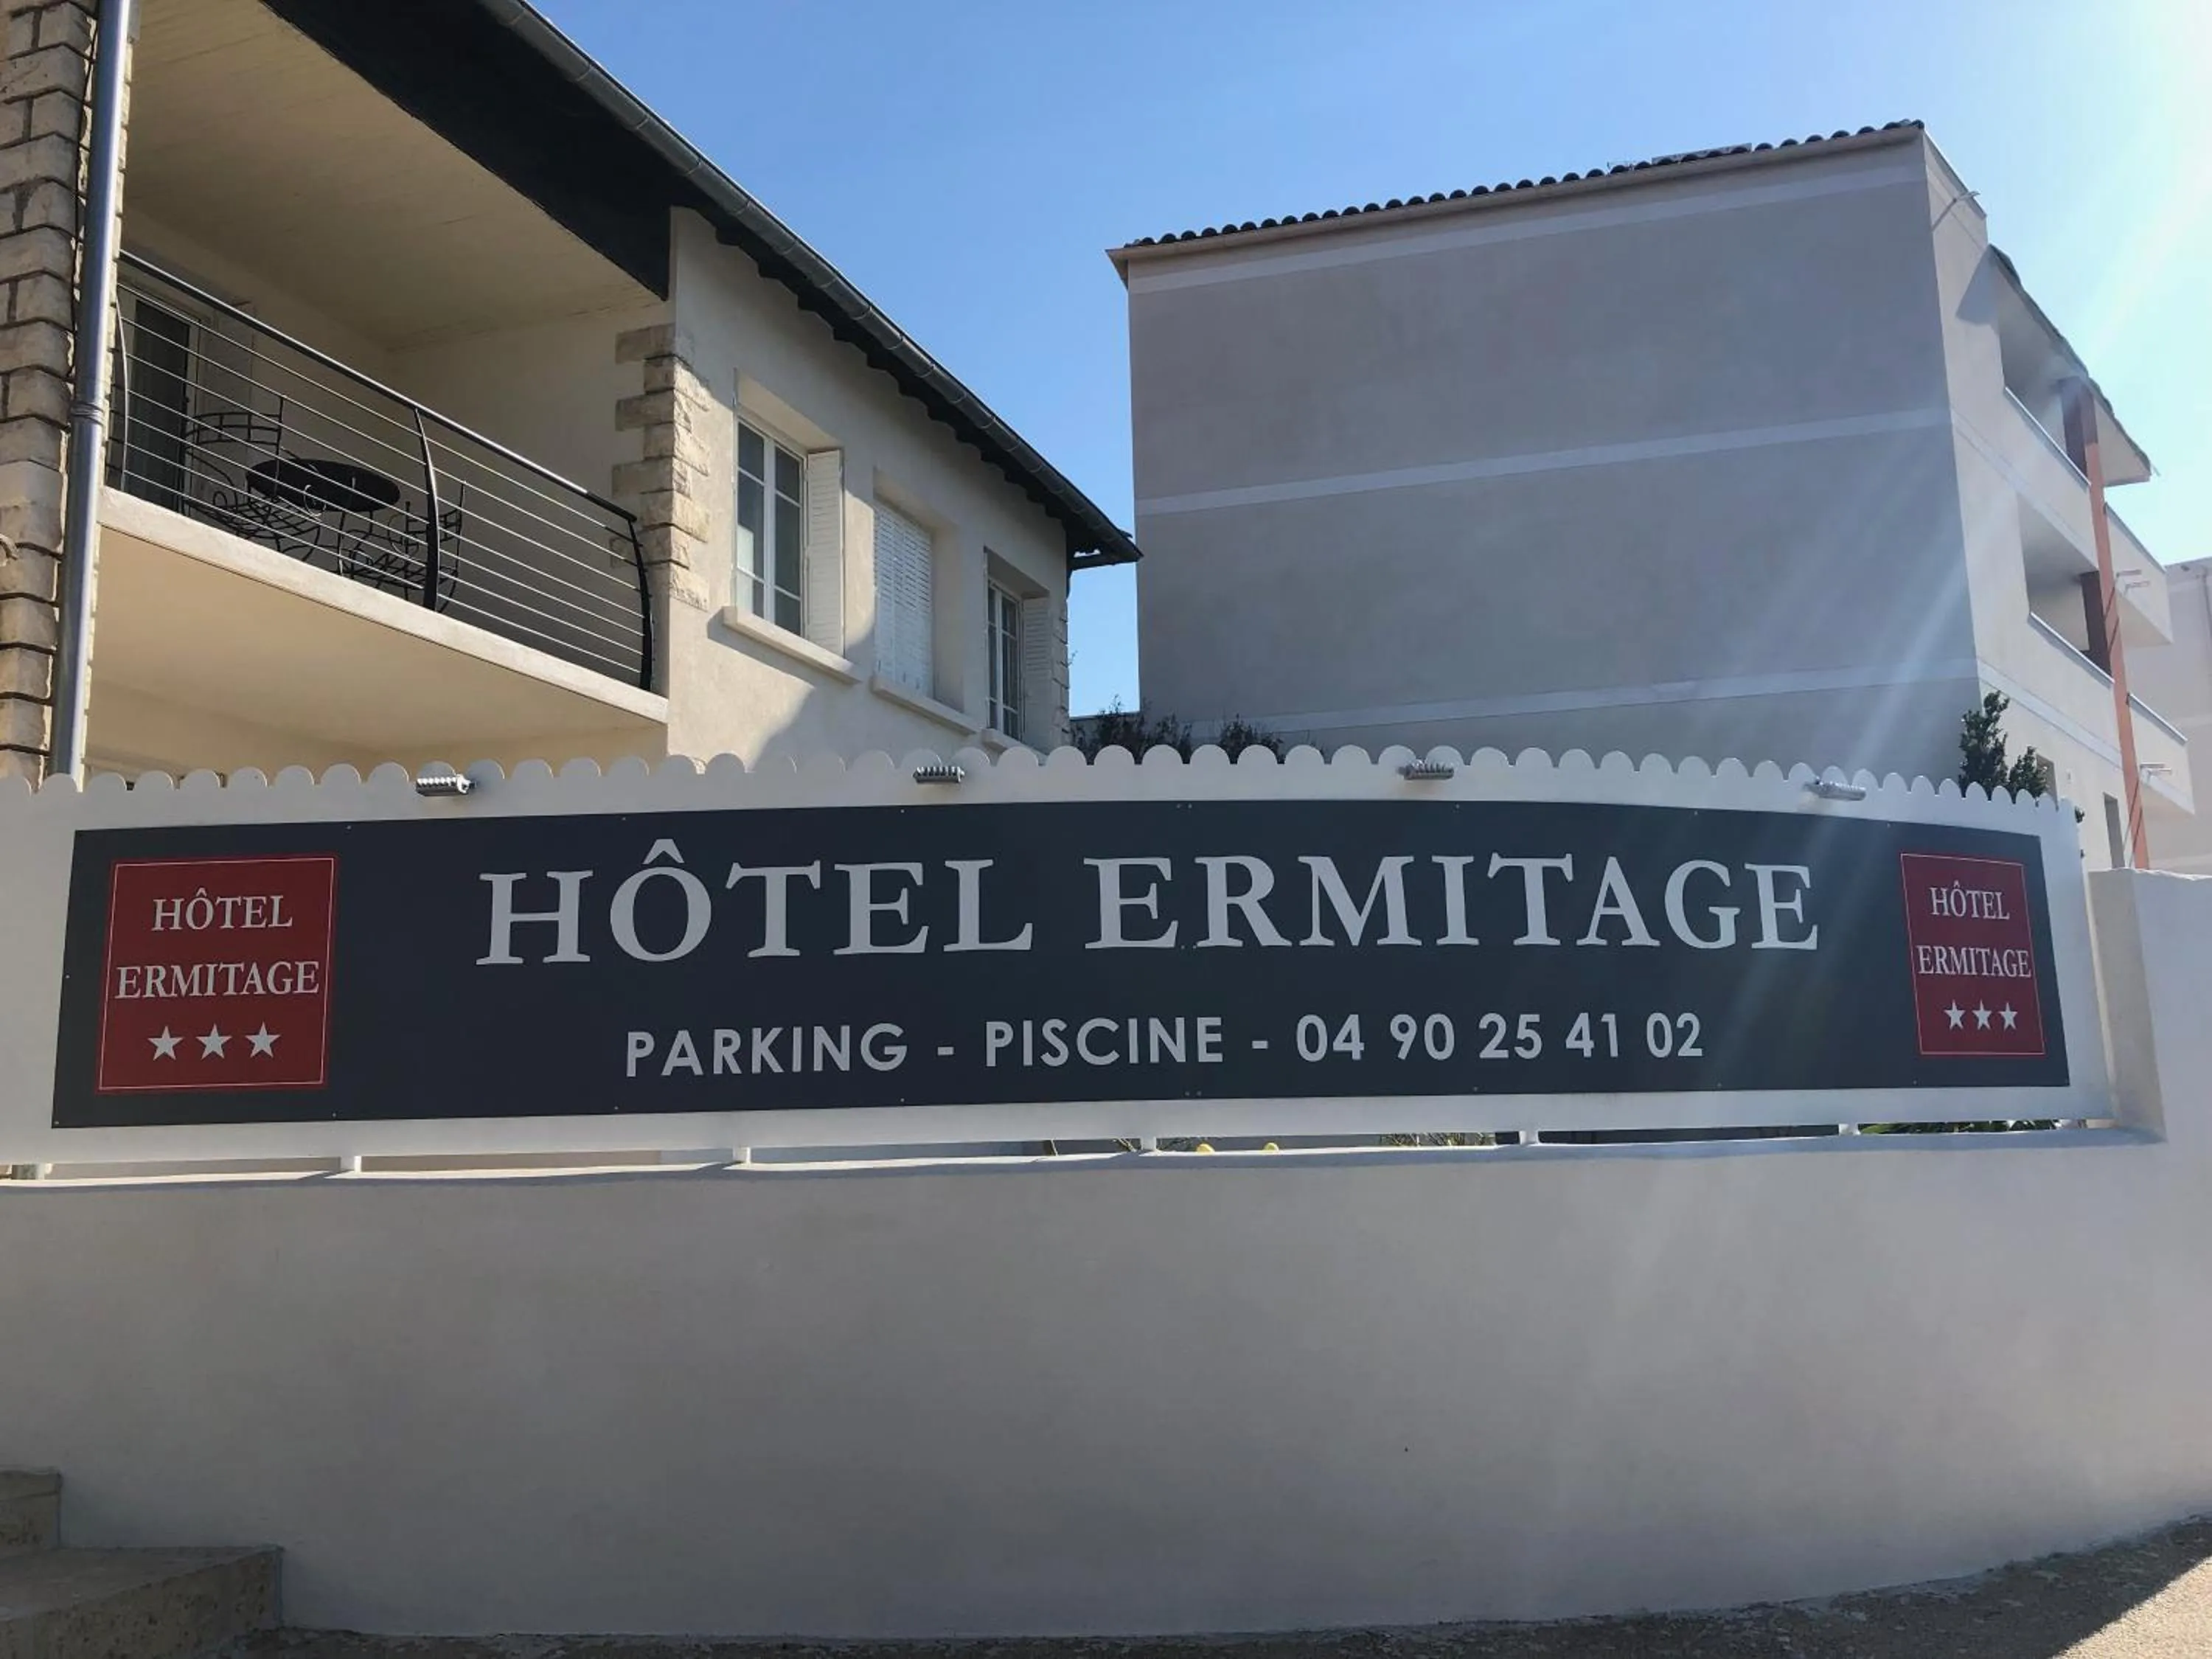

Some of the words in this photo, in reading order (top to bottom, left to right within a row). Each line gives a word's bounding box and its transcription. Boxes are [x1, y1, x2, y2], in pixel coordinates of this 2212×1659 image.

[151, 886, 293, 931] HÔTEL
[476, 838, 1033, 967] HÔTEL
[1084, 852, 1818, 950] ERMITAGE
[1929, 879, 2011, 921] HÔTEL
[114, 960, 320, 1000] ERMITAGE
[1916, 945, 2032, 978] ERMITAGE
[626, 1023, 908, 1078] PARKING
[986, 1016, 1223, 1067] PISCINE
[1296, 1013, 1365, 1062] 04
[1389, 1013, 1455, 1061] 90
[1478, 1012, 1543, 1060] 25
[1565, 1012, 1619, 1057] 41
[1646, 1012, 1703, 1059] 02
